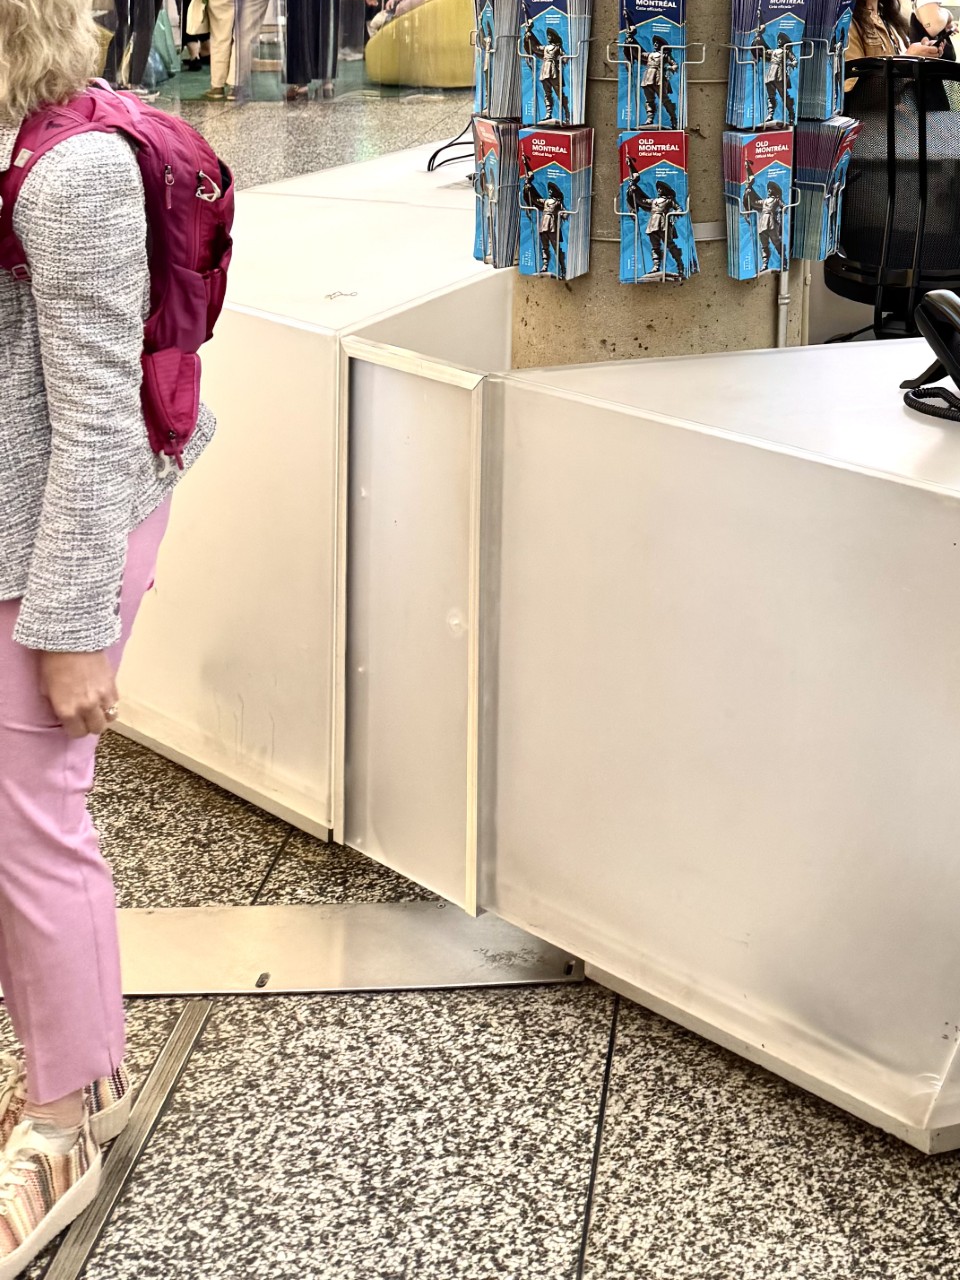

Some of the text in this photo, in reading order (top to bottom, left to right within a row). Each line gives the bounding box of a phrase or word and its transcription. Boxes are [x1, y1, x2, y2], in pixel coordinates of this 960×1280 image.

[635, 0, 677, 8] MONTRÉAL
[638, 143, 680, 151] MONTRÉAL
[755, 140, 769, 148] OLD
[532, 144, 568, 154] MONTRÉAL
[755, 145, 790, 154] MONTRÉAL
